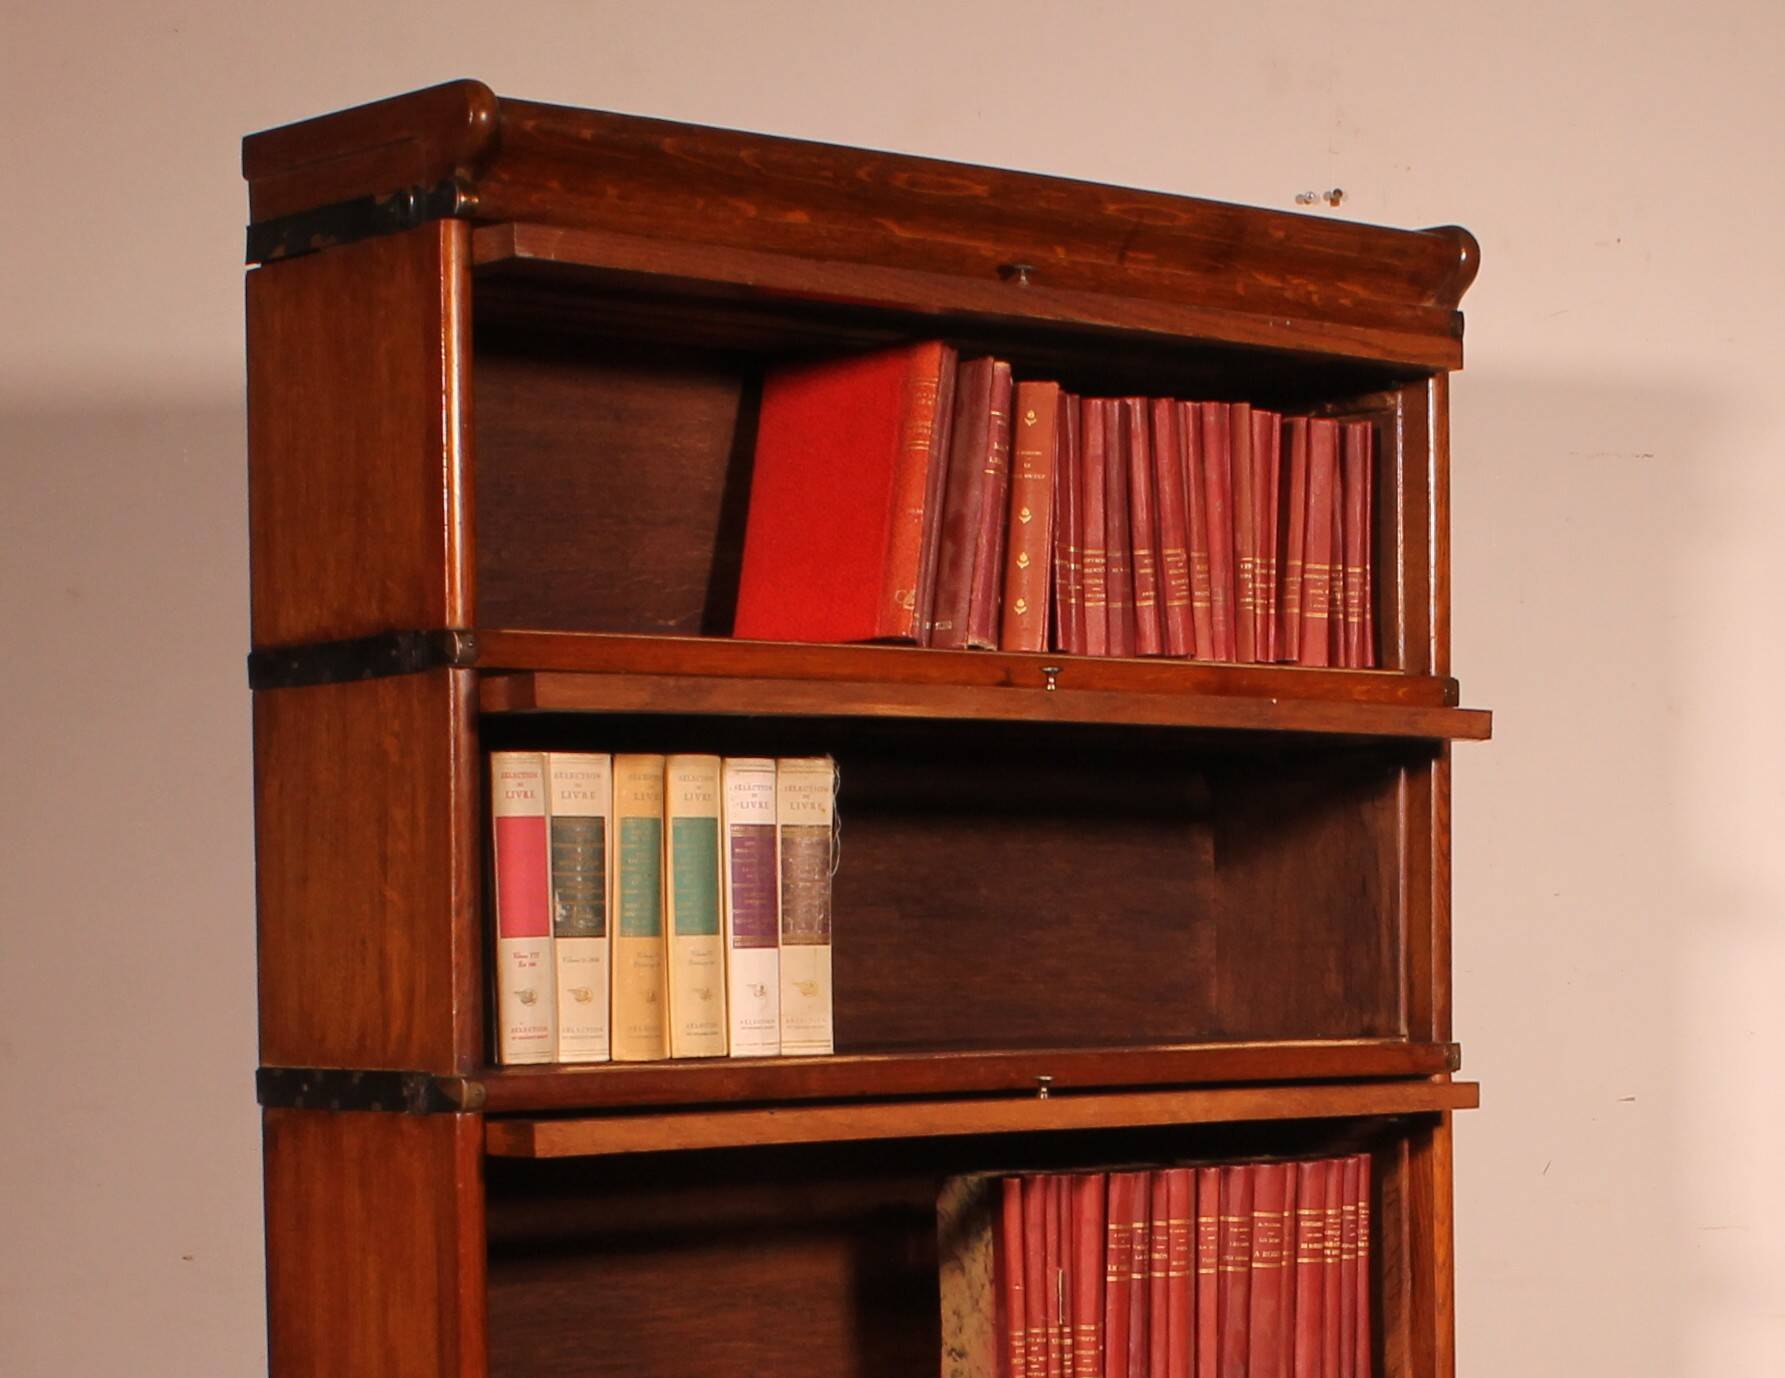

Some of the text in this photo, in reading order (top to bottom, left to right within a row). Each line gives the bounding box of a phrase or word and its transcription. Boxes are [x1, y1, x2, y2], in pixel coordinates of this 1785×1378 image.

[505, 790, 536, 800] LIVRE
[561, 791, 596, 801] LIVRE
[740, 801, 770, 810] LIVRE
[790, 802, 823, 811] LIVRE
